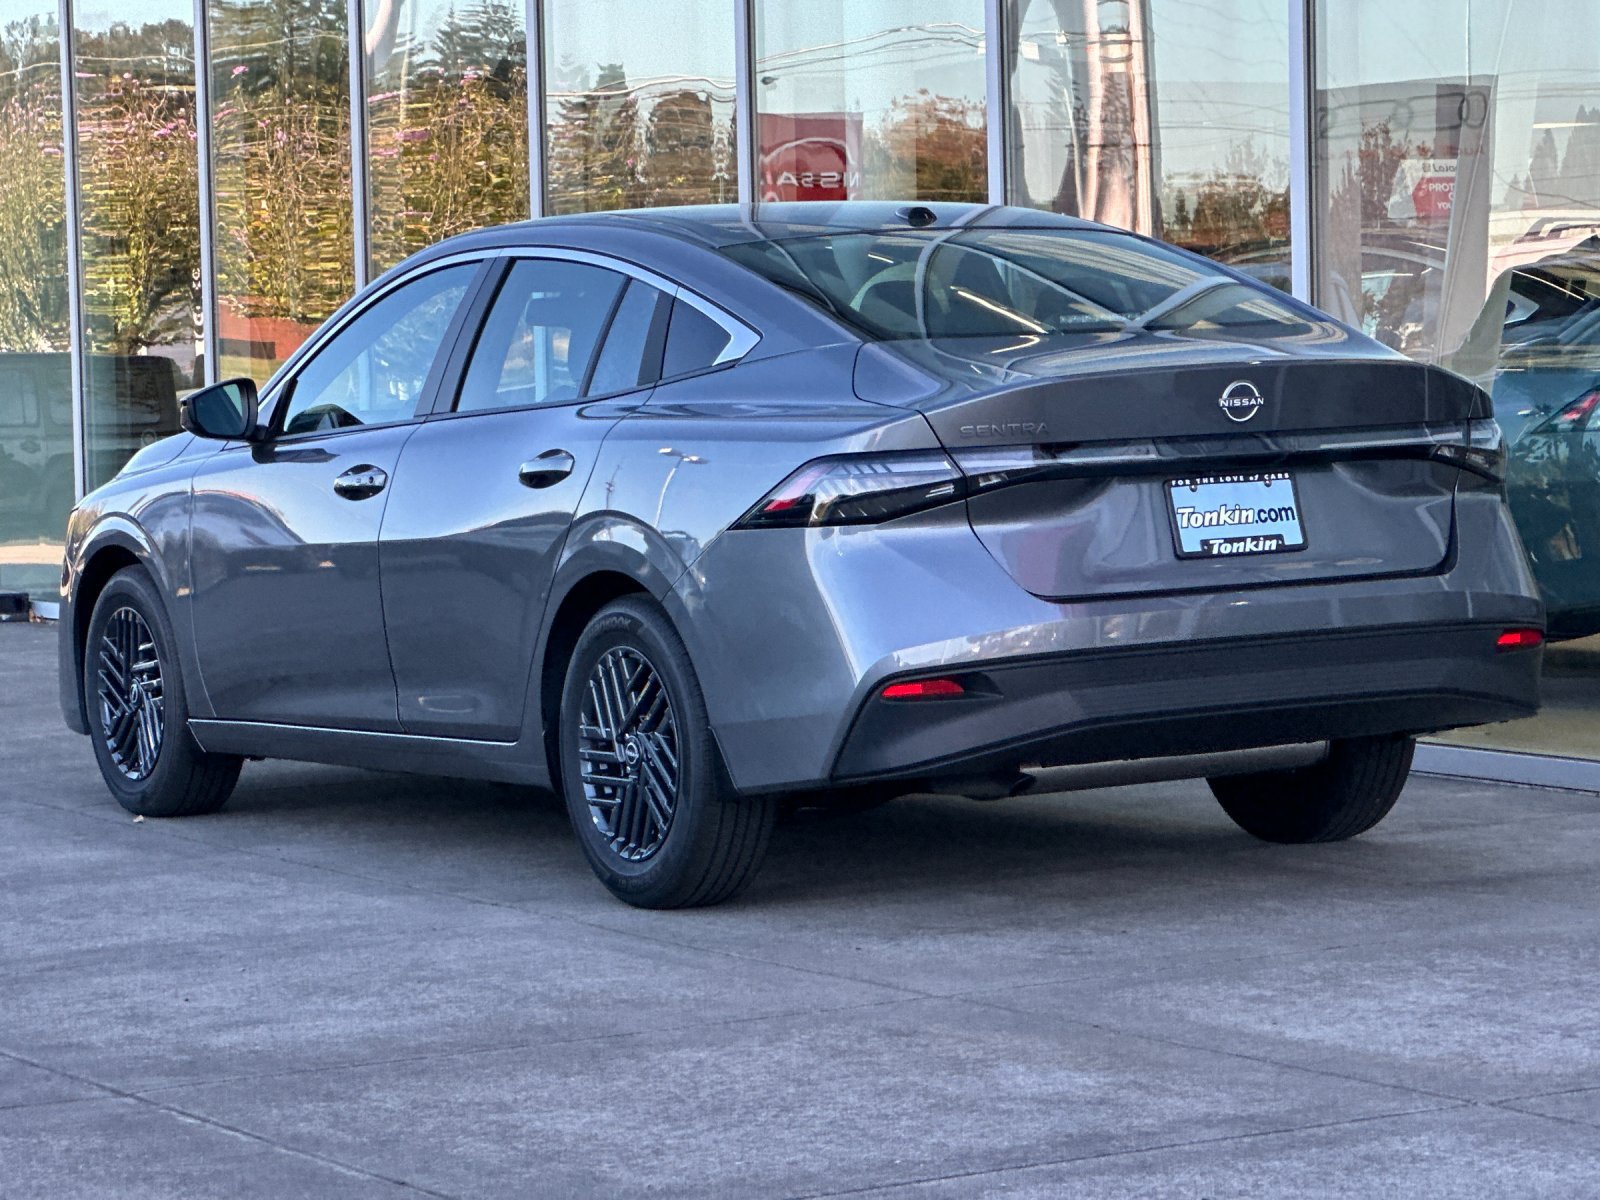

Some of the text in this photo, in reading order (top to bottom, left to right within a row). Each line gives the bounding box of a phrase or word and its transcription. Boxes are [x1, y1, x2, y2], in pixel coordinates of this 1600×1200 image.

[1218, 396, 1264, 407] NISSAN
[959, 422, 1049, 438] SENTRA
[1220, 475, 1244, 483] LOVE
[1264, 472, 1290, 480] CARS
[1177, 504, 1296, 529] Tonkin.com
[1209, 537, 1278, 555] Tonkin
